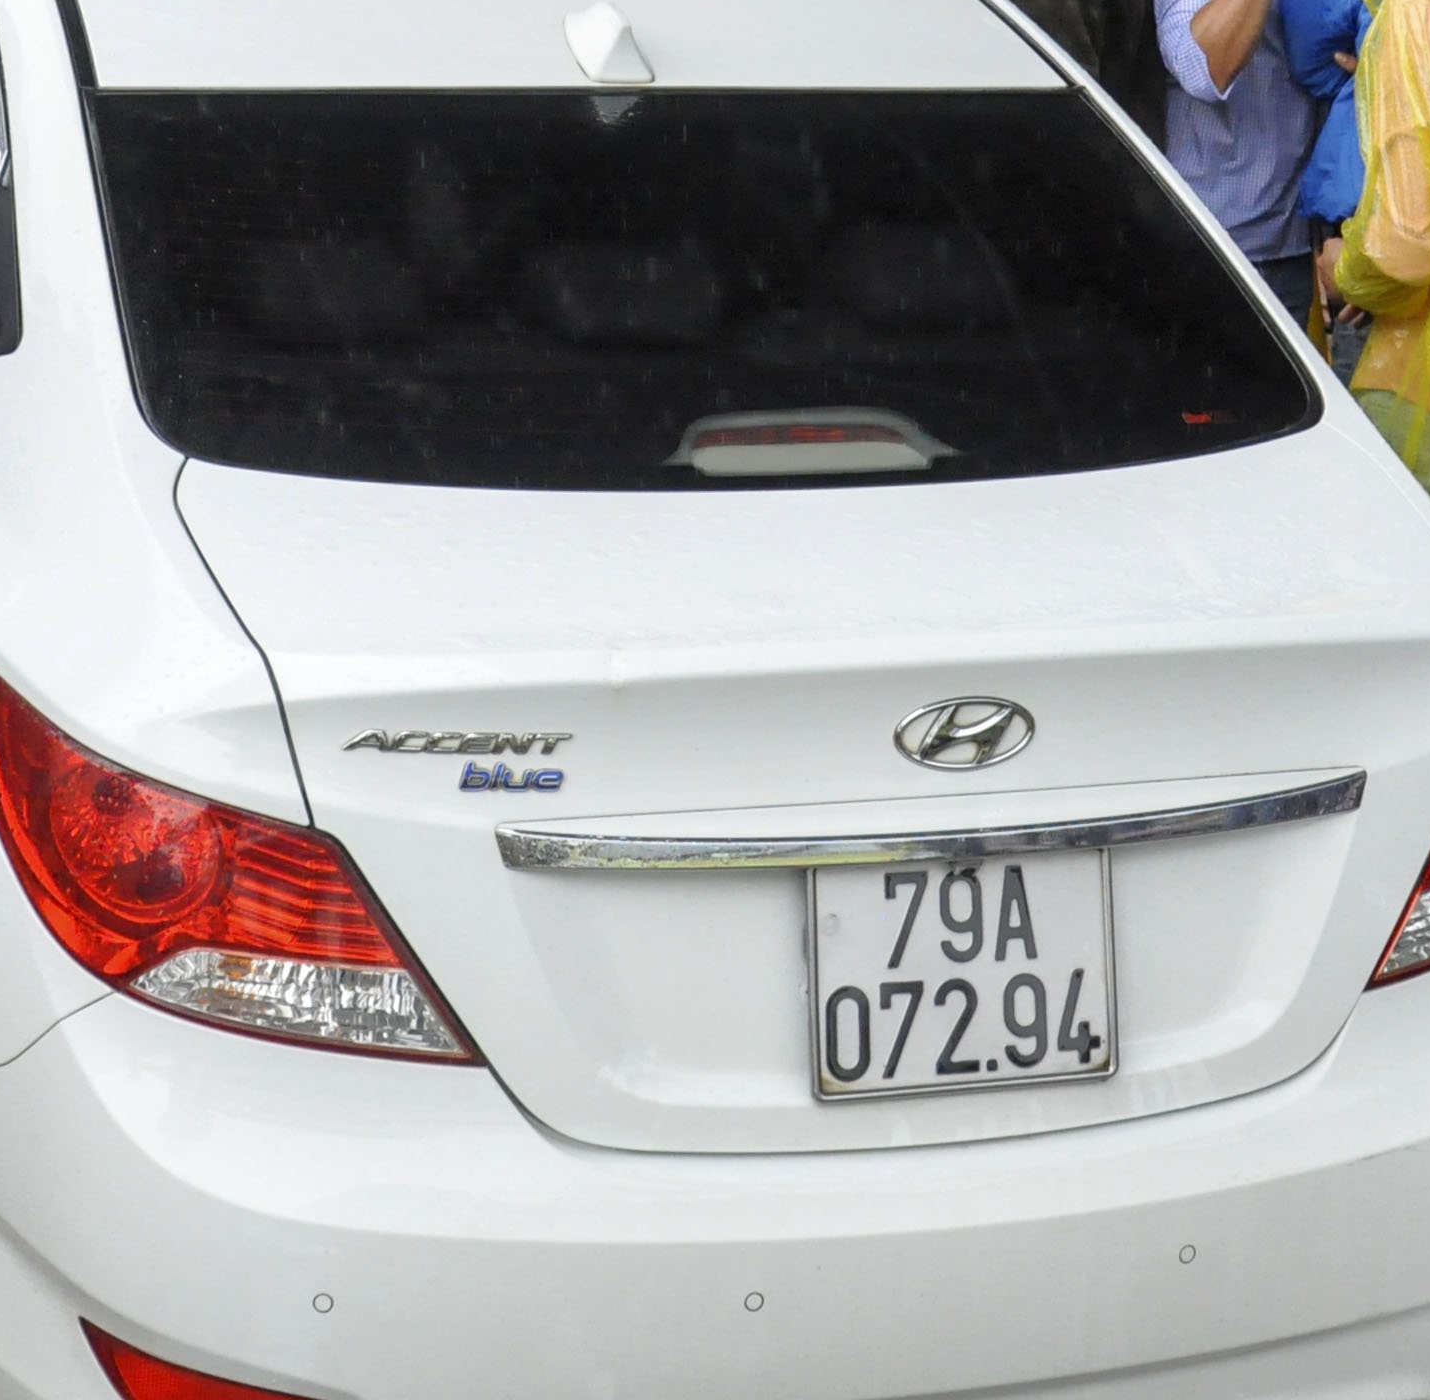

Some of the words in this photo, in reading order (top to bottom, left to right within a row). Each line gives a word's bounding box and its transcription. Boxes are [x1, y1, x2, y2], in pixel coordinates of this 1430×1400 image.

[342, 729, 572, 755] ACCENT
[459, 760, 564, 793] blue
[883, 865, 1038, 970] 79A
[825, 968, 1101, 1083] 072.94
